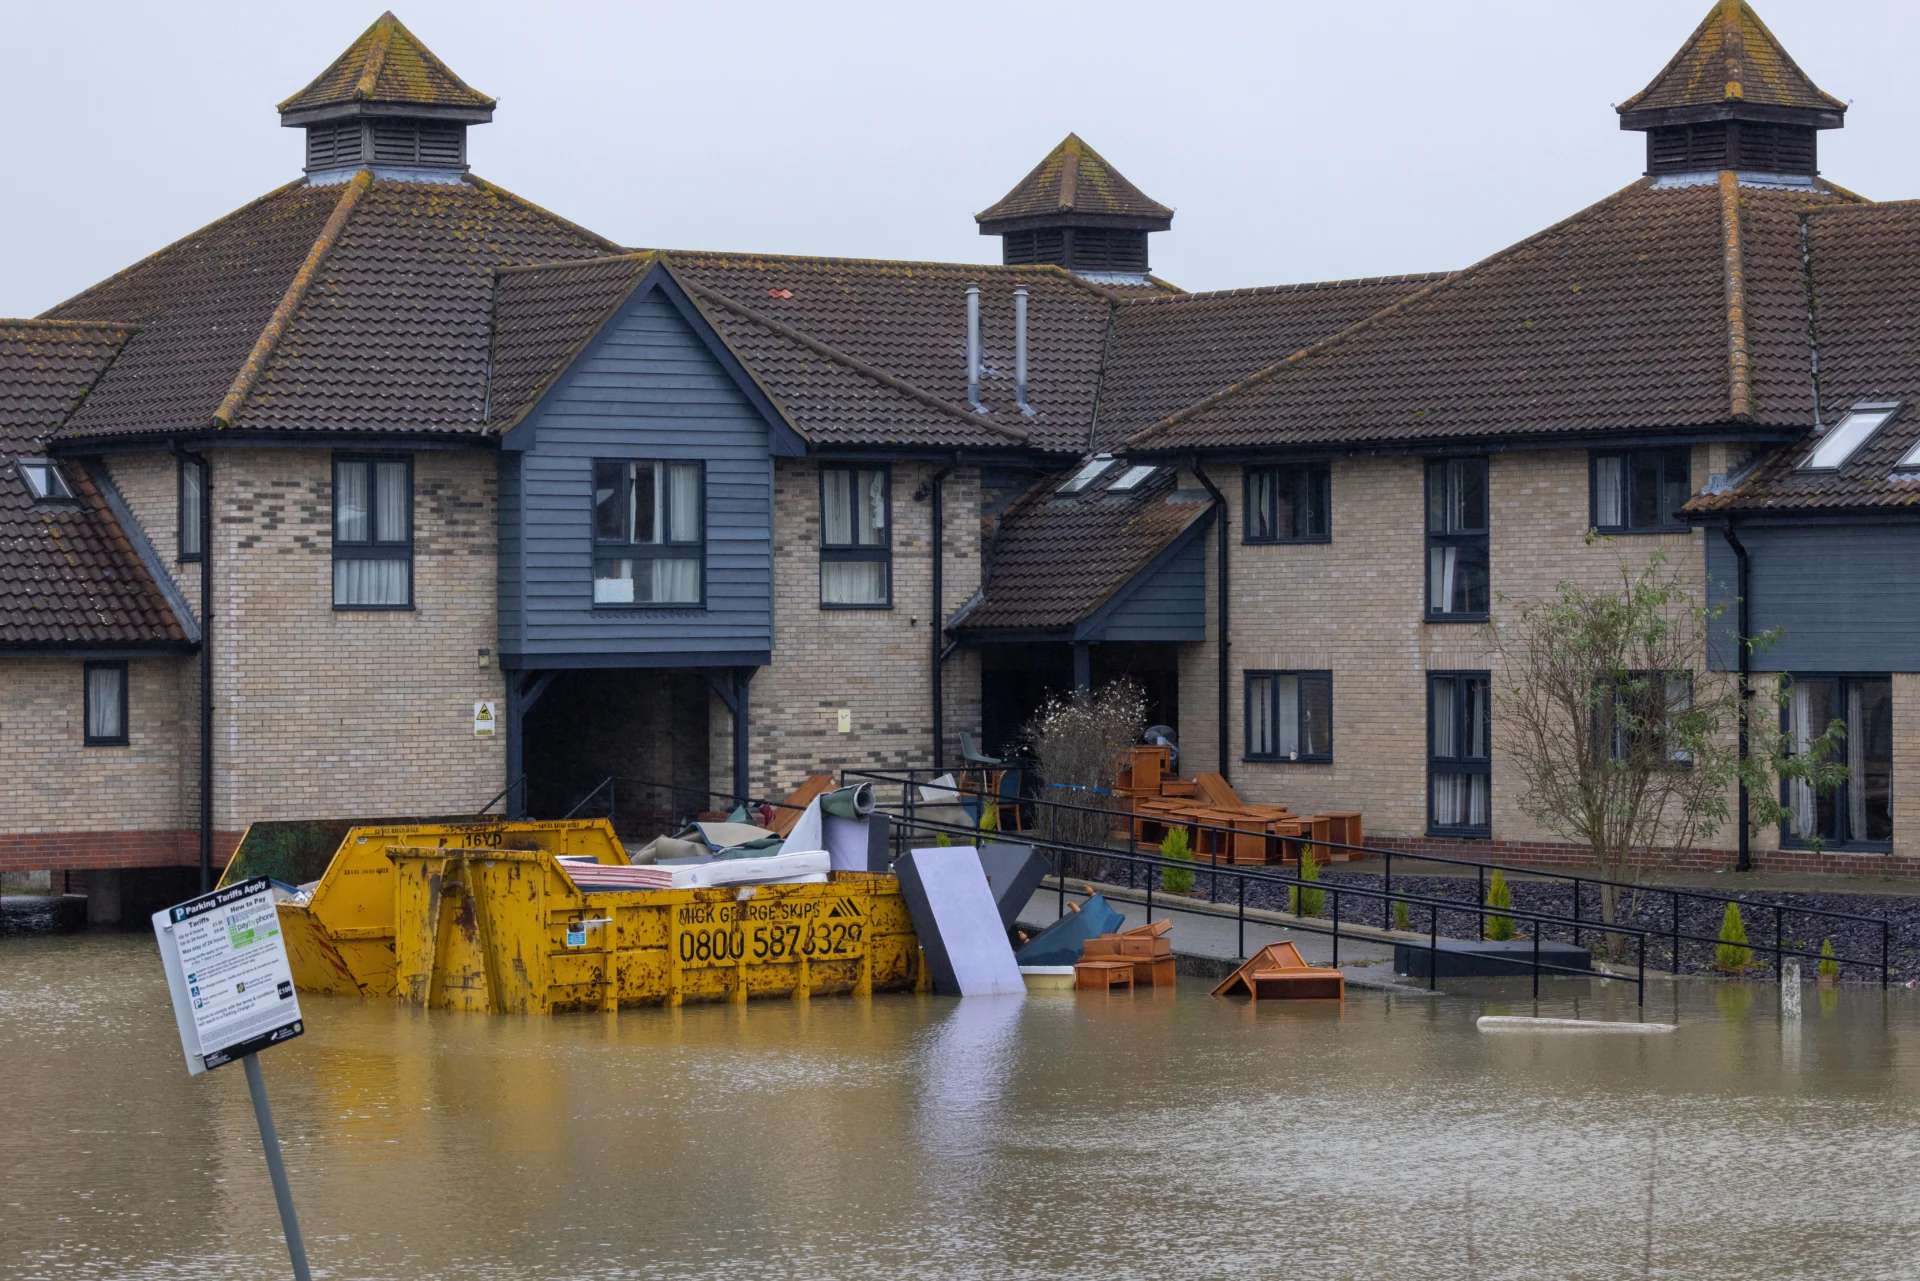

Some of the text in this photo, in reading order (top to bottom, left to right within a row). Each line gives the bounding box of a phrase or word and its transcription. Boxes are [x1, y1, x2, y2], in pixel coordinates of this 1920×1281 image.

[465, 832, 502, 847] 16YD
[186, 900, 216, 914] Parking
[217, 889, 242, 903] Tariffs
[244, 881, 266, 894] Apply
[230, 905, 245, 913] How
[679, 900, 820, 924] MICK GERGE SKIPS
[189, 917, 209, 928] Tariffs
[237, 913, 274, 931] paybyphone
[679, 928, 745, 962] 0800
[278, 985, 292, 995] £100
